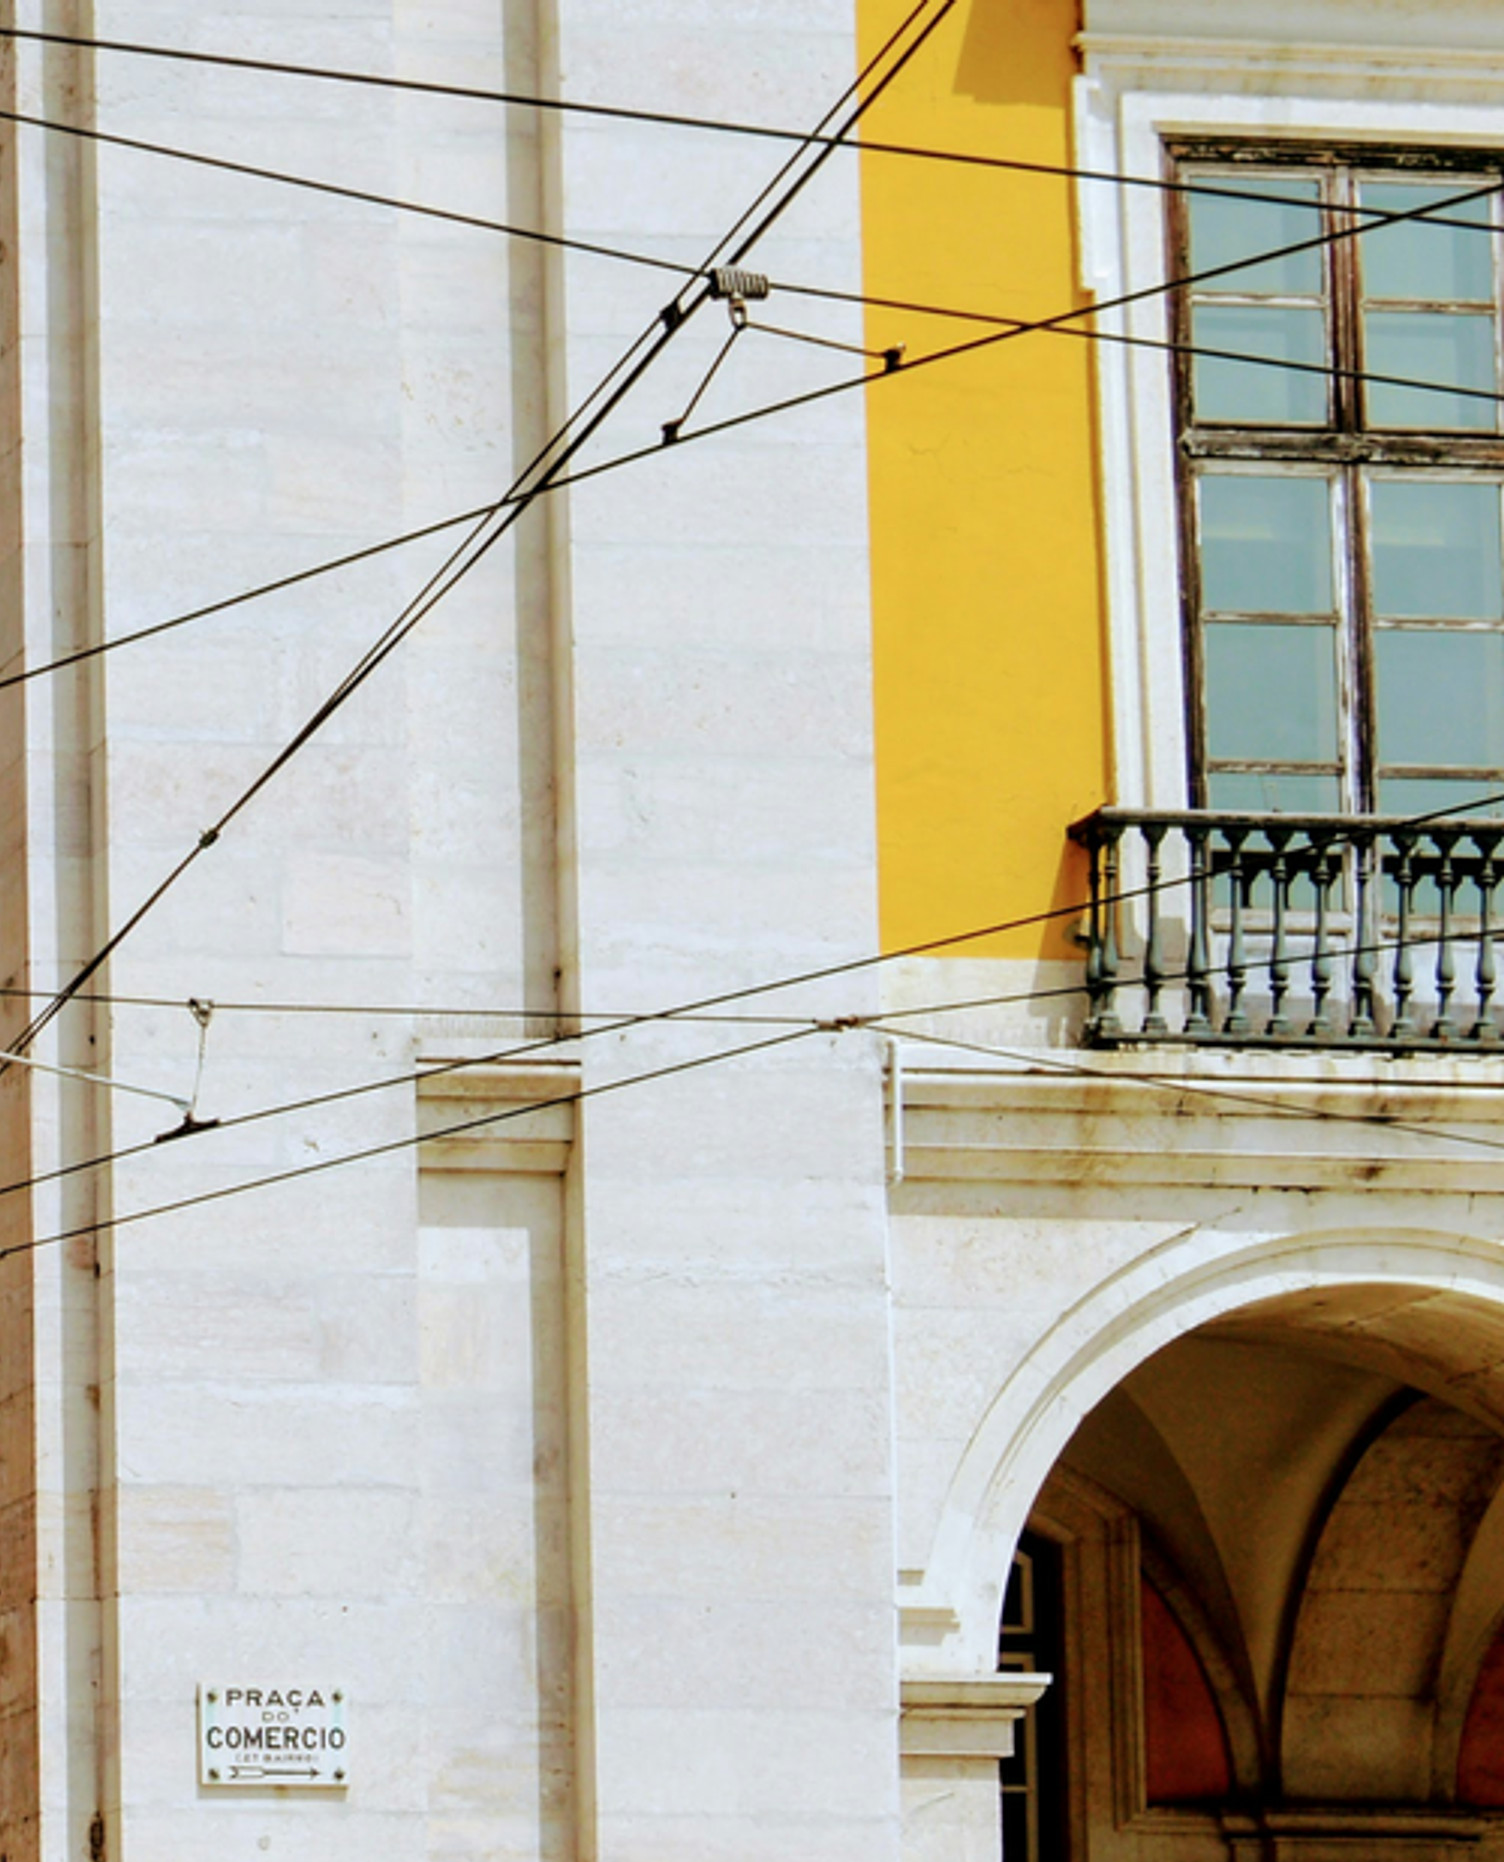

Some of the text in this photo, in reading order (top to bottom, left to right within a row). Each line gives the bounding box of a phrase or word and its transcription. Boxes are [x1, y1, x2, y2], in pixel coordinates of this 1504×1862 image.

[225, 1689, 325, 1714] PRAÇA
[261, 1711, 289, 1722] DO
[206, 1726, 346, 1749] COMERCIO
